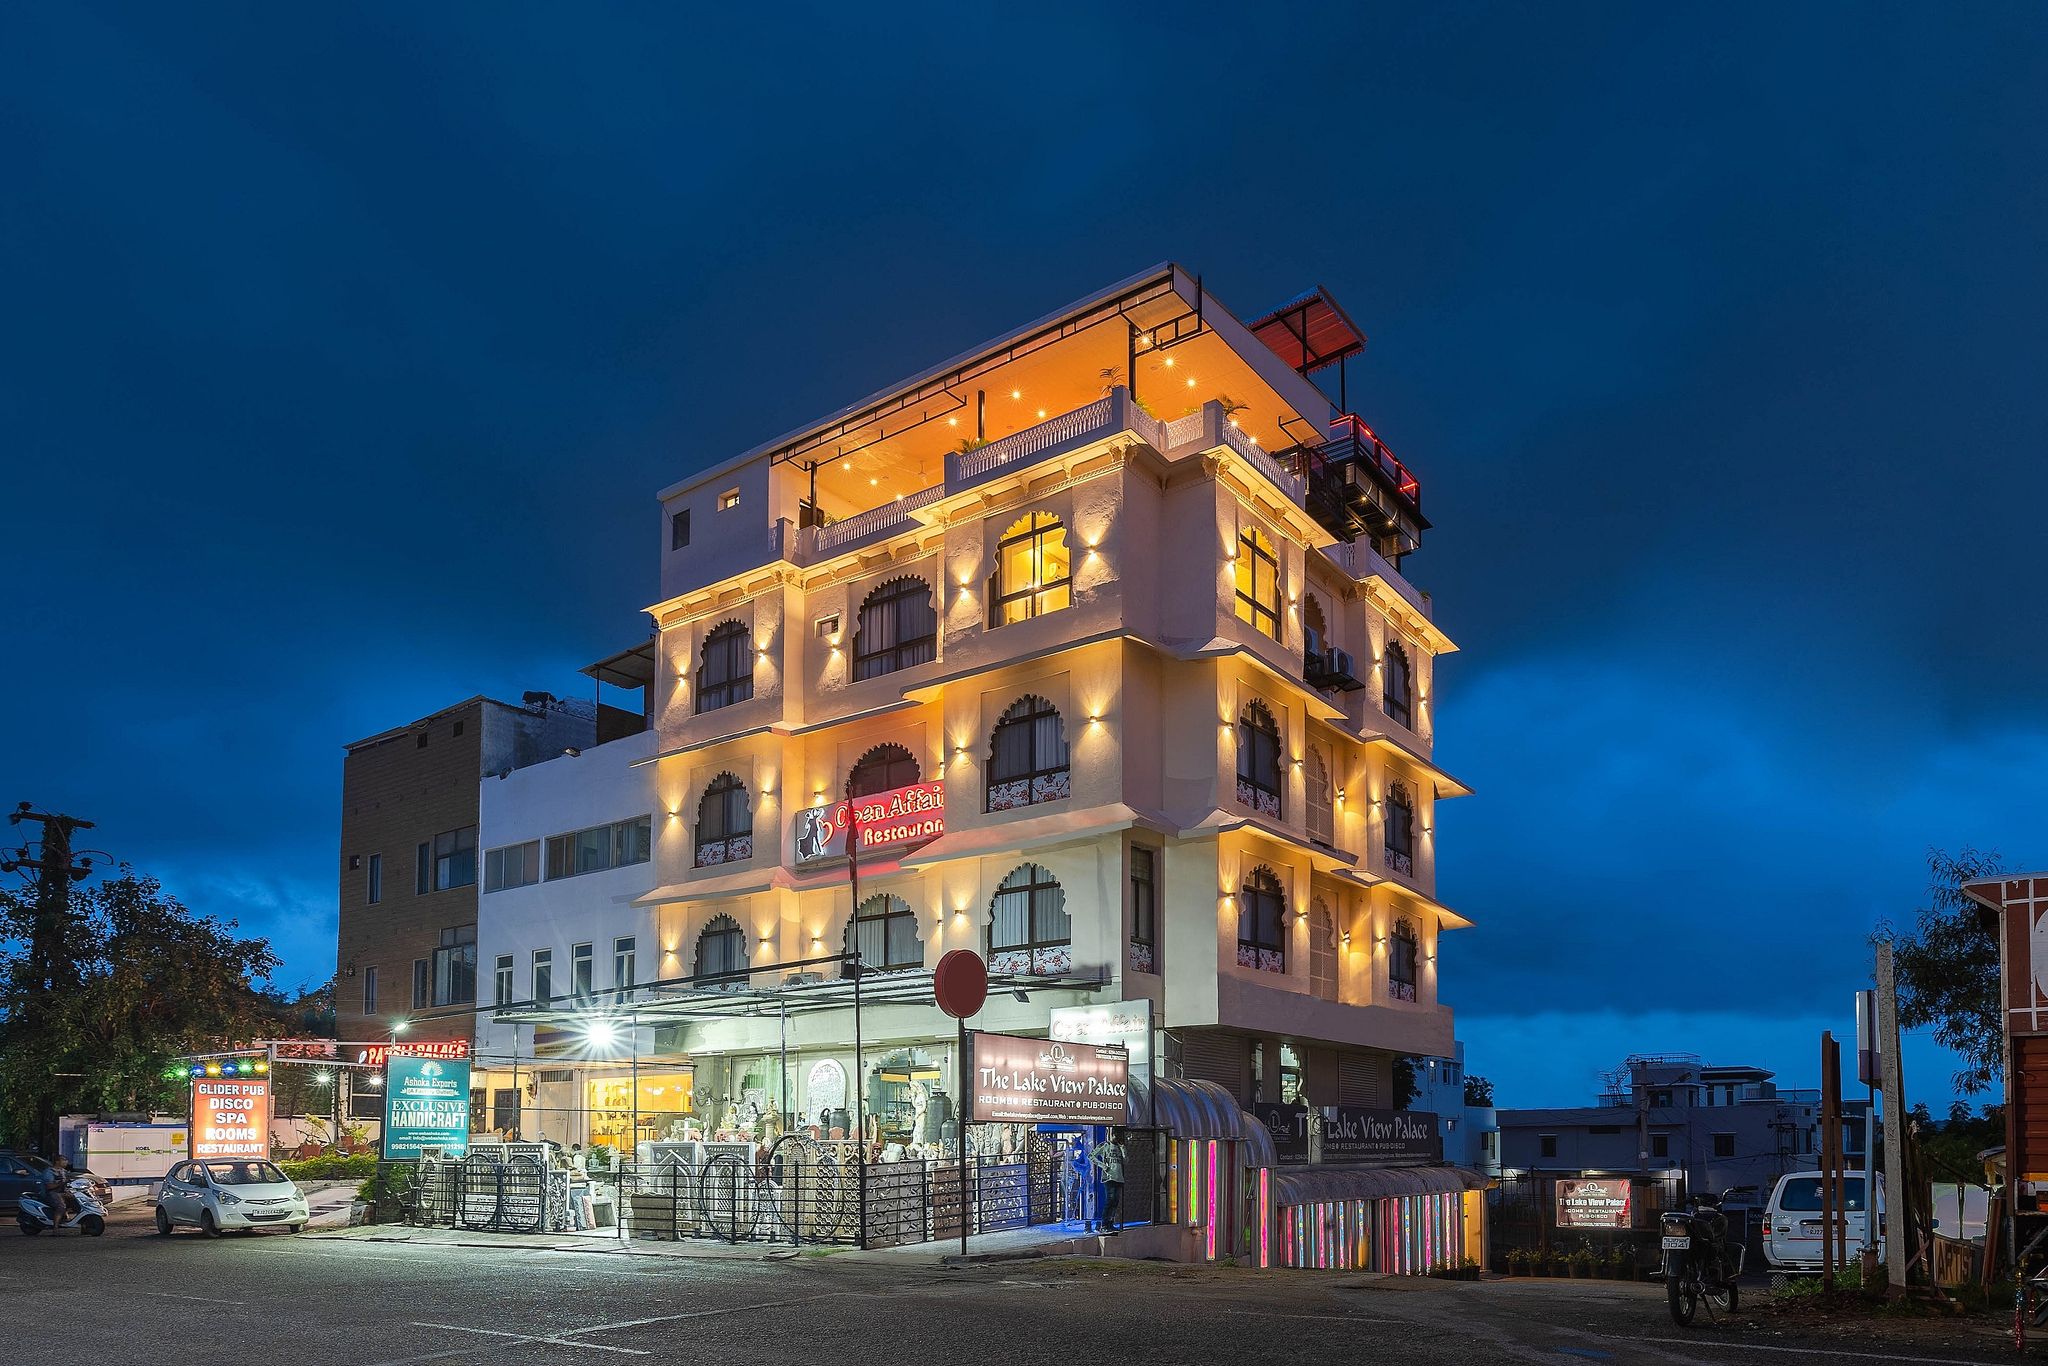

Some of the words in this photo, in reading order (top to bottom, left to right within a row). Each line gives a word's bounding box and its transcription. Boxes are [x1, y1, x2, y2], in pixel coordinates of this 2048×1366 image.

[404, 1076, 430, 1087] Ashoka
[432, 1077, 457, 1088] Exports
[979, 1067, 1009, 1090] The
[1013, 1071, 1047, 1092] Lake
[1050, 1074, 1085, 1094] View
[1088, 1076, 1126, 1096] Palace
[199, 1084, 240, 1095] GLIDER
[242, 1085, 265, 1095] PUB
[209, 1097, 254, 1110] DISCO
[392, 1101, 466, 1112] EXCLUSIVE
[1022, 1097, 1076, 1107] RESTAURANT
[1082, 1101, 1123, 1110] PUB-DISCO
[215, 1112, 247, 1124] SPA
[391, 1111, 467, 1128] HANDICRAFT
[1328, 1113, 1357, 1139] Lake
[1361, 1115, 1392, 1139] View
[1395, 1115, 1428, 1139] Palace
[205, 1128, 257, 1140] ROOMS
[197, 1143, 264, 1153] RESTAURANT
[1571, 1198, 1587, 1206] Lake
[1588, 1198, 1605, 1206] View
